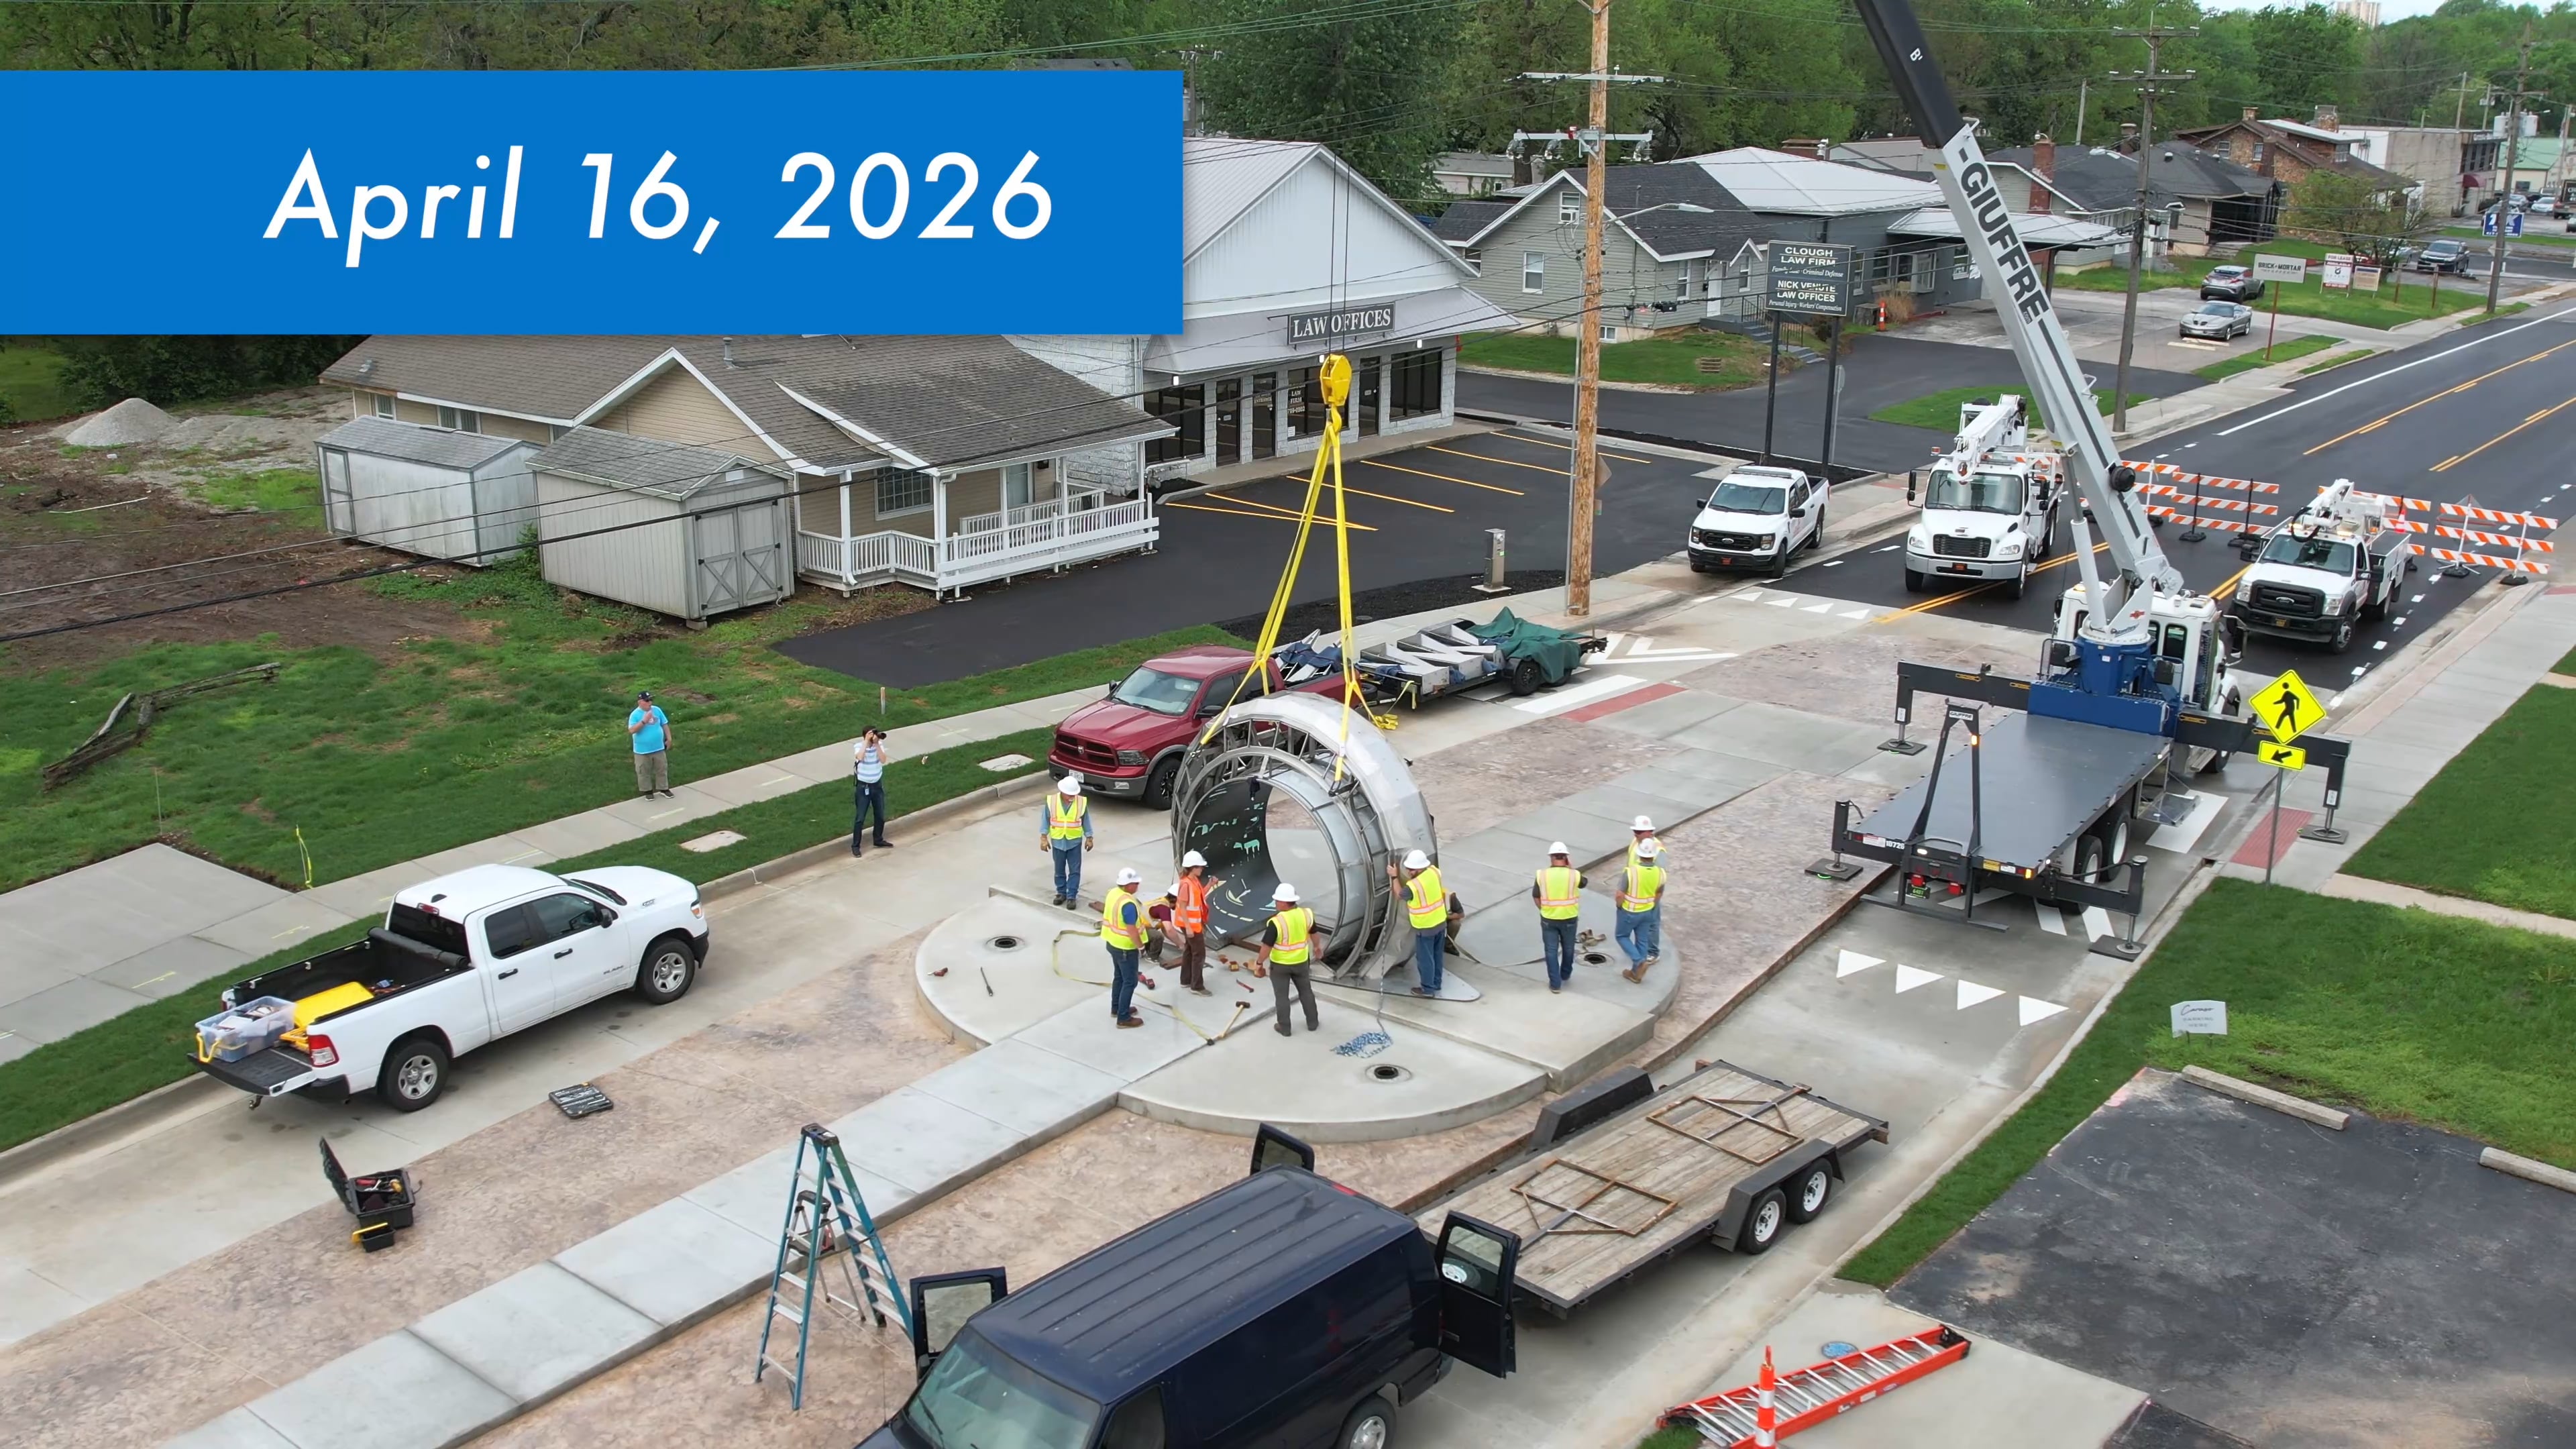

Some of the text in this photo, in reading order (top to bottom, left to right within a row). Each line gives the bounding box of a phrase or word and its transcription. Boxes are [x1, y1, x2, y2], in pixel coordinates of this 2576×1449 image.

[1961, 162, 2049, 317] GIUFFRE
[1784, 247, 1833, 257] CLOUGH
[1780, 256, 1836, 266] LAW FIRM
[1778, 280, 1799, 289] NICK
[1776, 290, 1835, 303] LAW OFFICES
[1293, 309, 1391, 337] LAW OFFICES
[1290, 396, 1302, 405] FIRM
